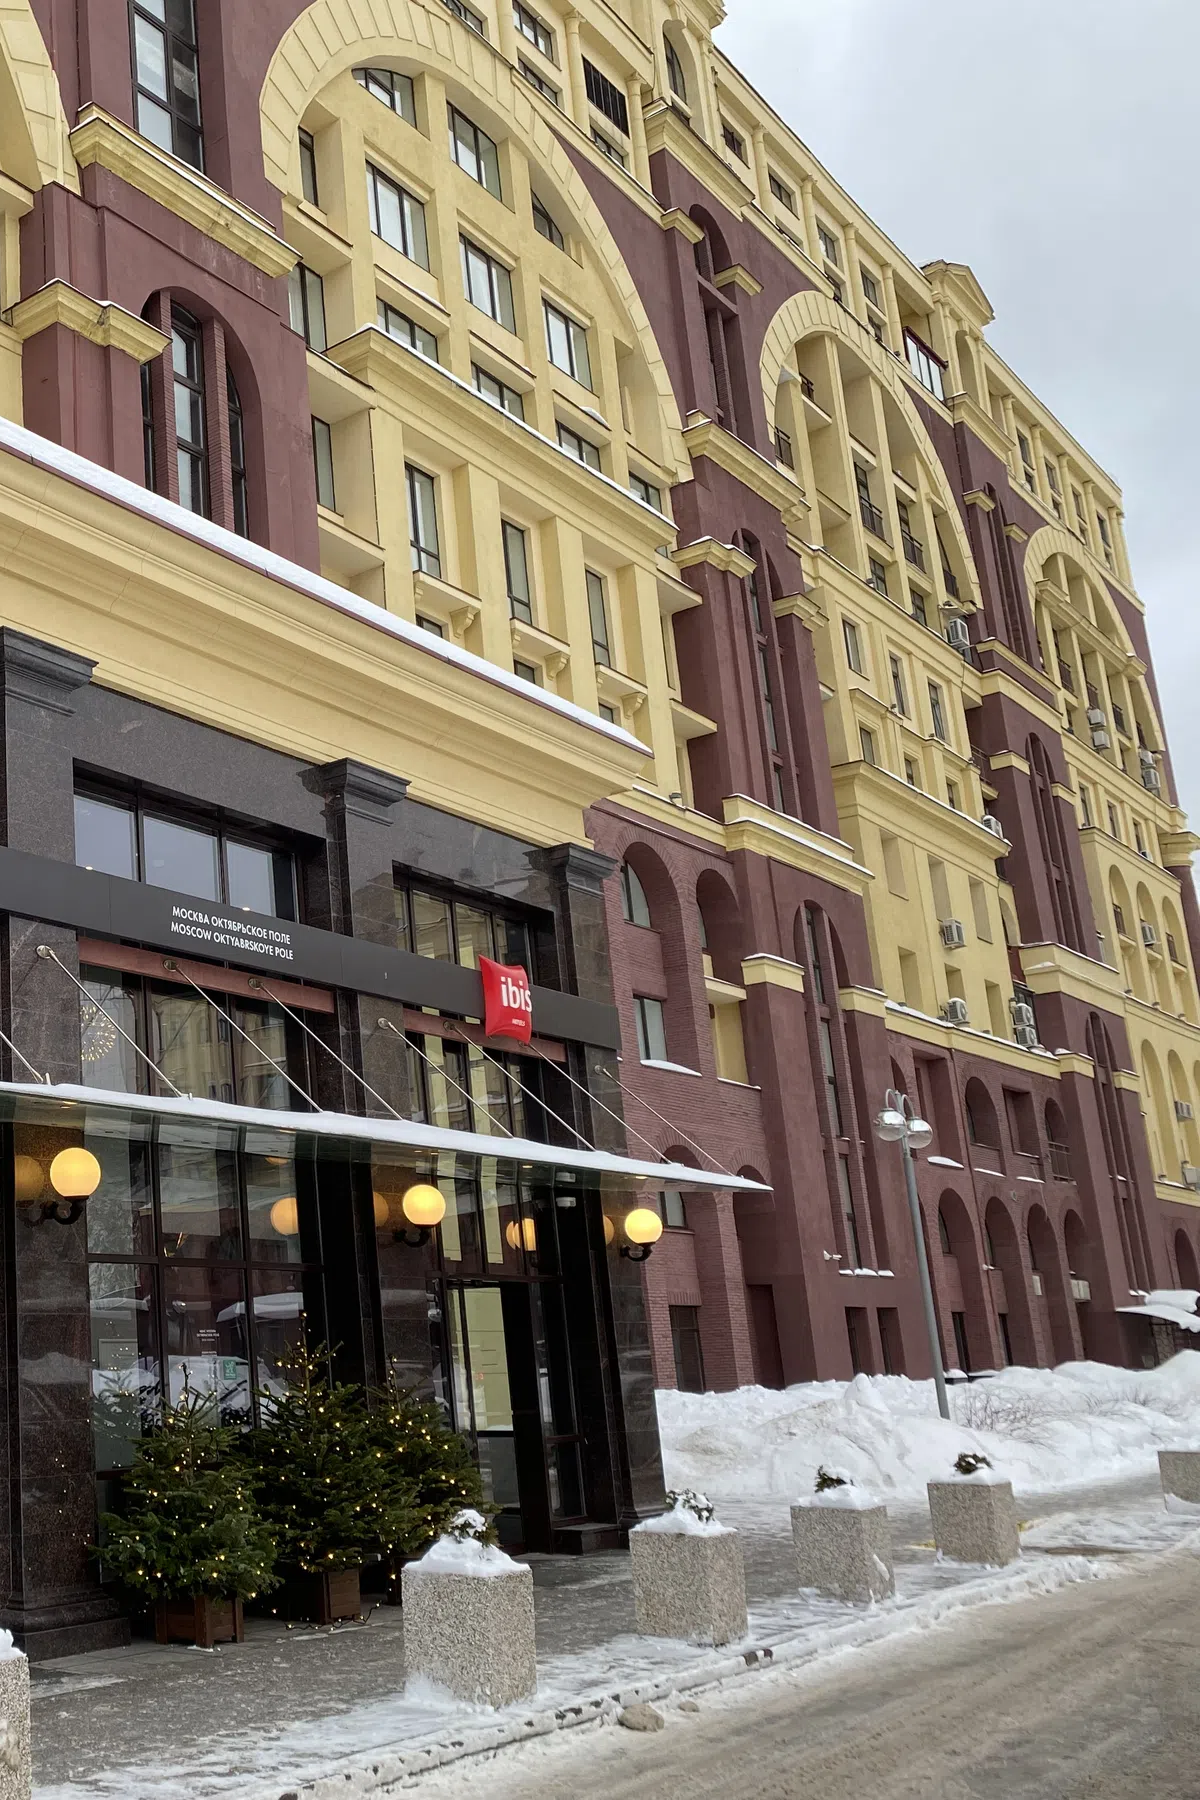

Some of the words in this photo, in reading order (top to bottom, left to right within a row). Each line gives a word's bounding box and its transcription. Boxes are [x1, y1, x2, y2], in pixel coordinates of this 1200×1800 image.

[171, 921, 212, 941] MOSCOW
[213, 931, 274, 956] OKTYABRSKOYE
[274, 946, 294, 960] POLE
[172, 905, 210, 925] МОСКВА
[211, 915, 268, 940] ОКТЯБРЬСКОЕ
[268, 929, 291, 945] ПОЛЕ
[501, 976, 532, 1012] ibis
